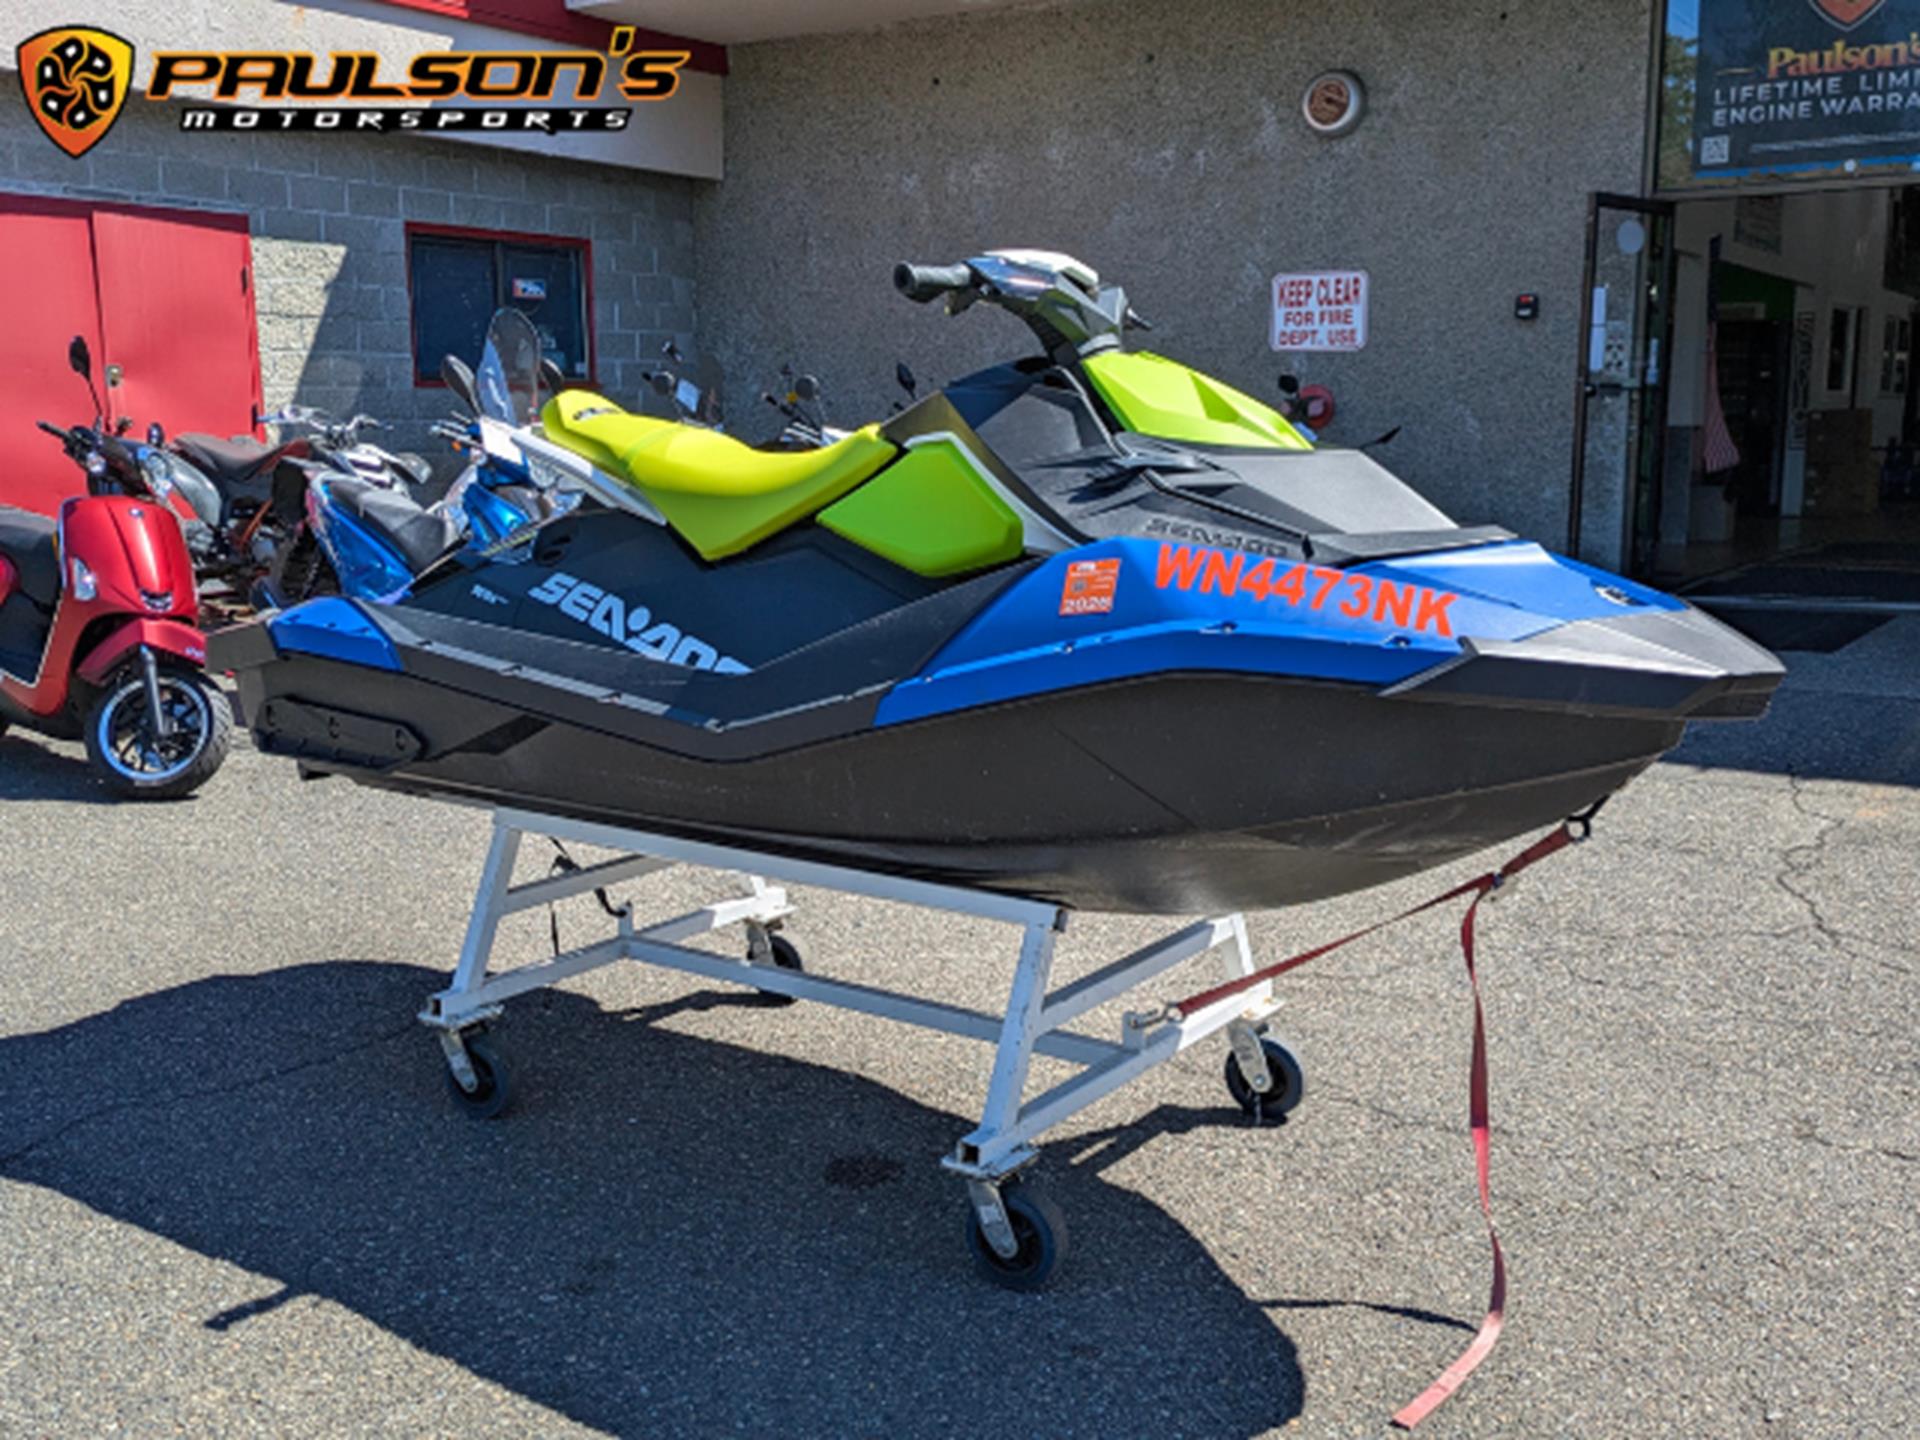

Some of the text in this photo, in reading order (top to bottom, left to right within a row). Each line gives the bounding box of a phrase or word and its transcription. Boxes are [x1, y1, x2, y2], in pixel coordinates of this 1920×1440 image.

[1714, 77, 1842, 106] LIFETIME
[1712, 100, 1813, 127] ENGINE
[1278, 276, 1360, 308] KEEP CLEAR
[1284, 308, 1353, 327] FOR FIRE
[1327, 328, 1356, 345] USE
[1155, 543, 1459, 638] WN4473NK
